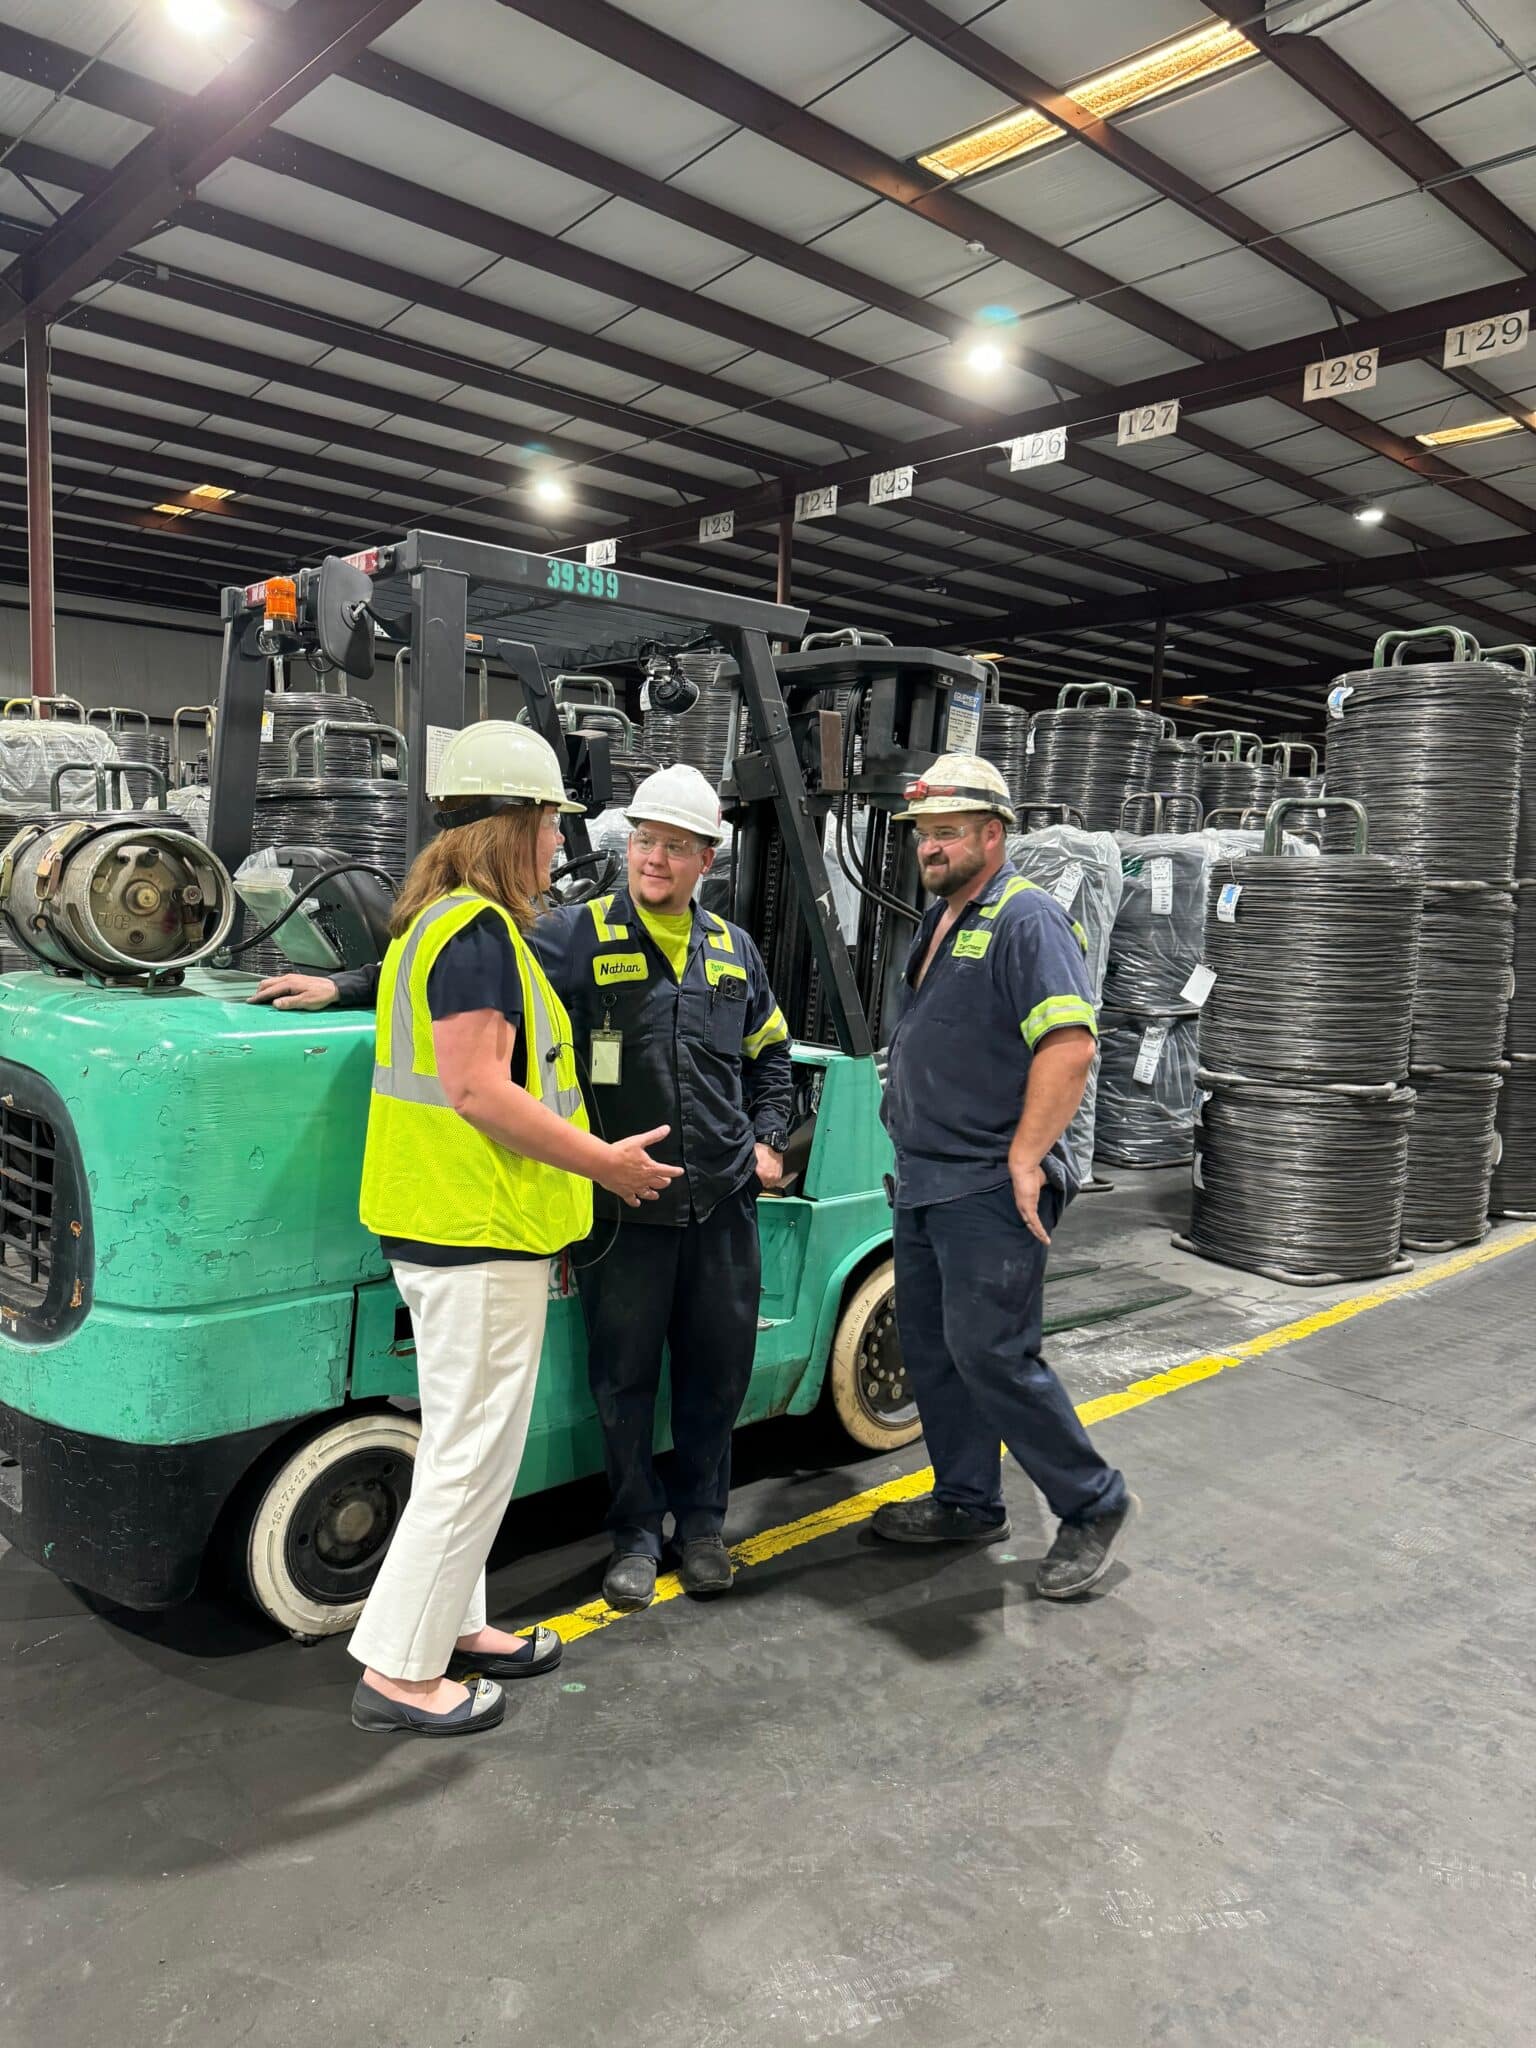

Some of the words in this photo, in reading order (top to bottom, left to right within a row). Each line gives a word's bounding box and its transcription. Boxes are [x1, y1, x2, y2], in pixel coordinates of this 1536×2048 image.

[1454, 316, 1523, 357] 129
[1312, 354, 1372, 391] 128
[1124, 404, 1174, 437] 127
[1018, 433, 1061, 462] 126
[874, 469, 909, 497] 125
[799, 490, 834, 515] 124
[703, 514, 731, 536] 123
[547, 560, 618, 599] 39399
[600, 962, 641, 976] Nathan
